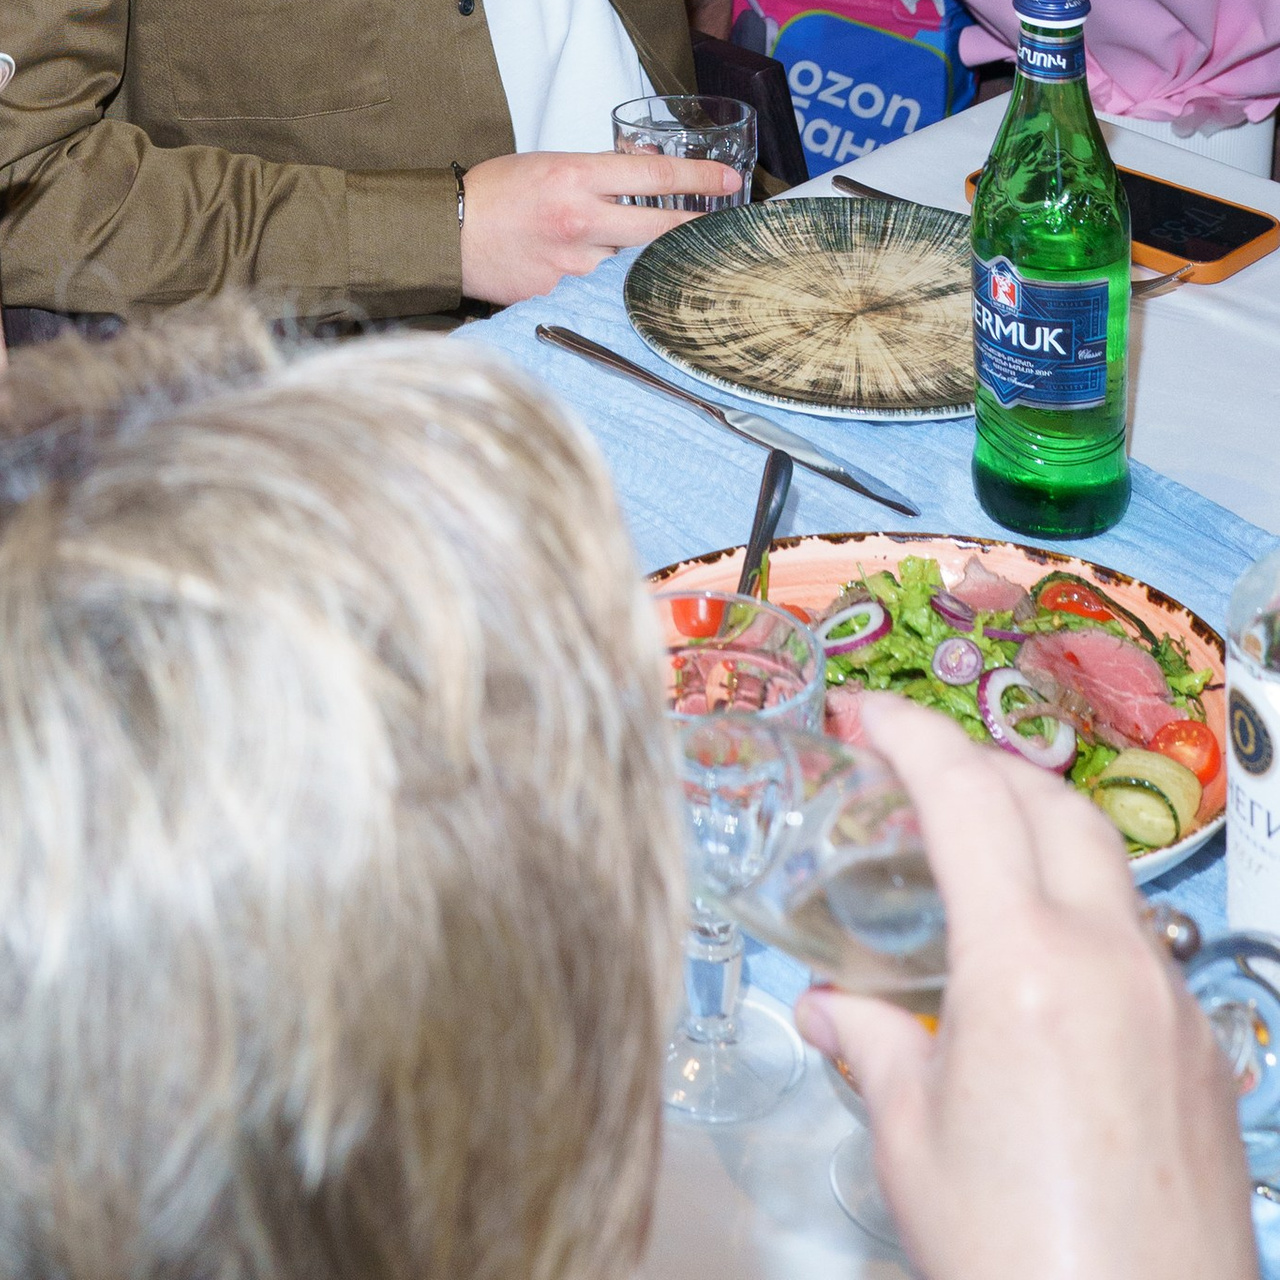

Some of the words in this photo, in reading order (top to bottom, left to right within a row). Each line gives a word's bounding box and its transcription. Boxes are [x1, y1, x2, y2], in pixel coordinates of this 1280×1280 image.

[788, 60, 921, 134] ozon
[791, 95, 885, 163] ан
[1149, 207, 1226, 243] 17:33
[974, 297, 1067, 355] ERMUK
